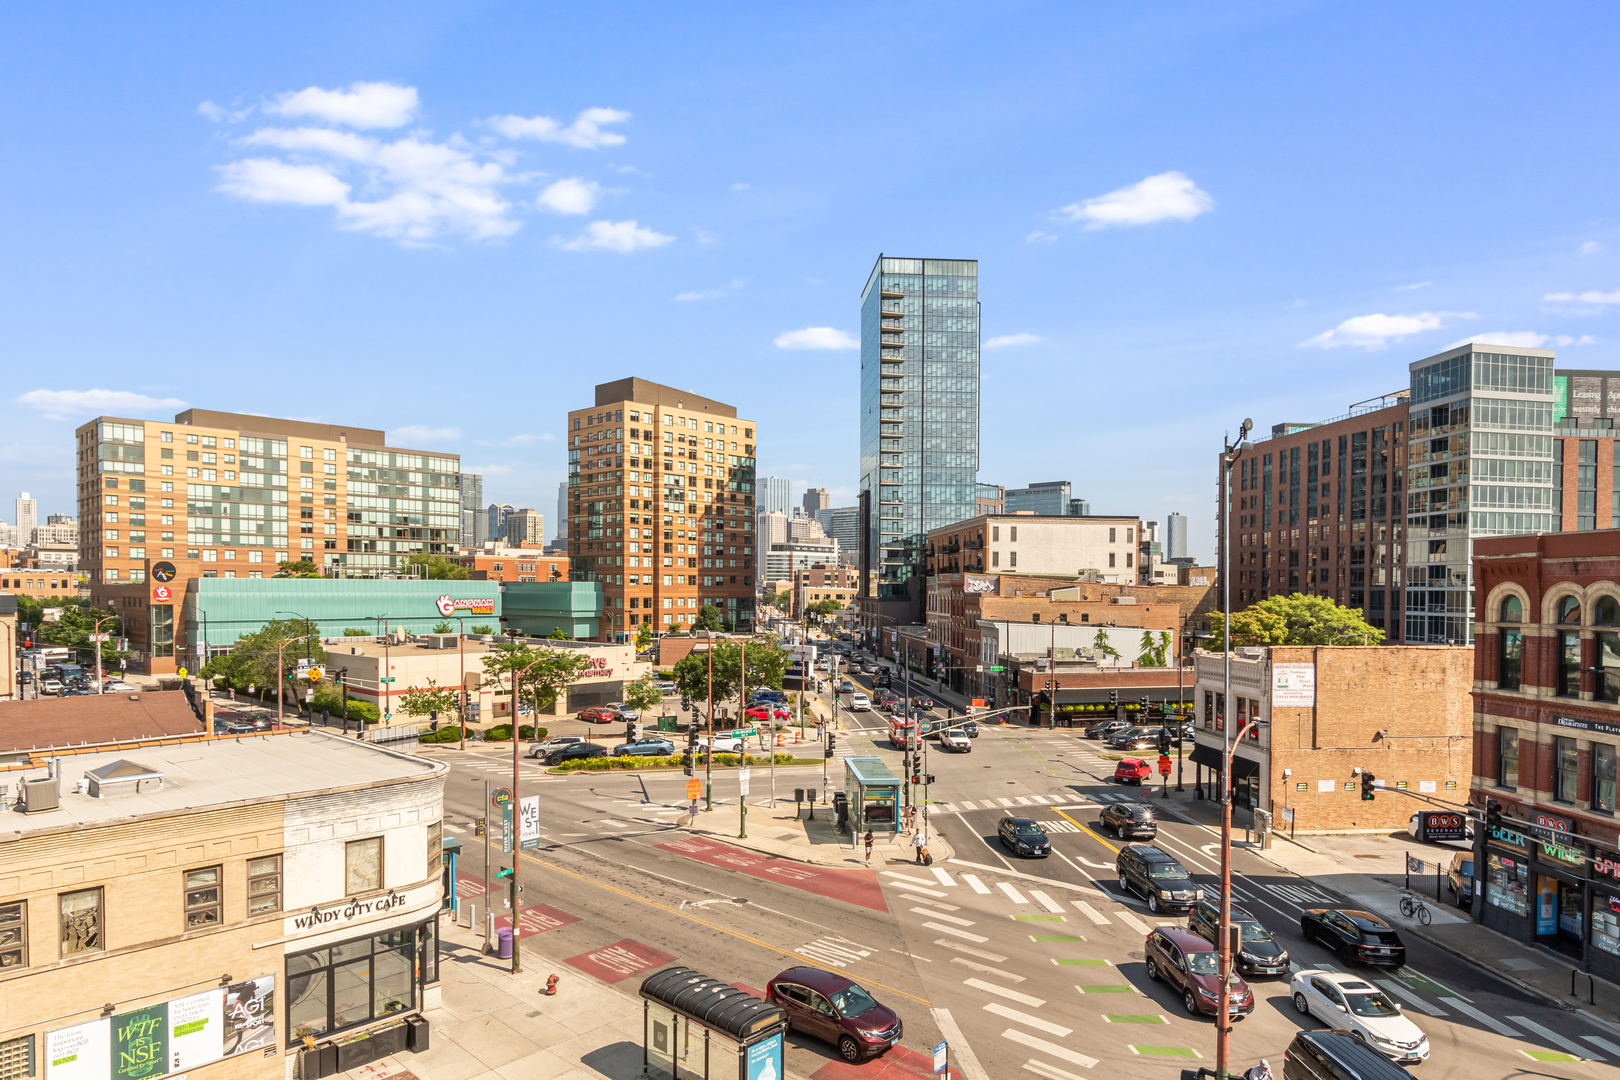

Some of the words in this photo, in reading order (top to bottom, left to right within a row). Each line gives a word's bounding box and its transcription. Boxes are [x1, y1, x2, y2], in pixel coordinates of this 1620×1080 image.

[1573, 390, 1601, 401] Leasing
[1572, 405, 1601, 414] westerly
[497, 794, 509, 802] cta
[1535, 828, 1568, 841] BEVEAGE
[294, 910, 341, 929] WINDY
[344, 903, 373, 918] CITY
[375, 895, 406, 911] CAFE
[794, 934, 879, 968] ONLY
[228, 997, 264, 1019] AG1
[118, 1017, 162, 1042] WTF
[136, 1037, 145, 1047] IS
[119, 1041, 162, 1068] NSF
